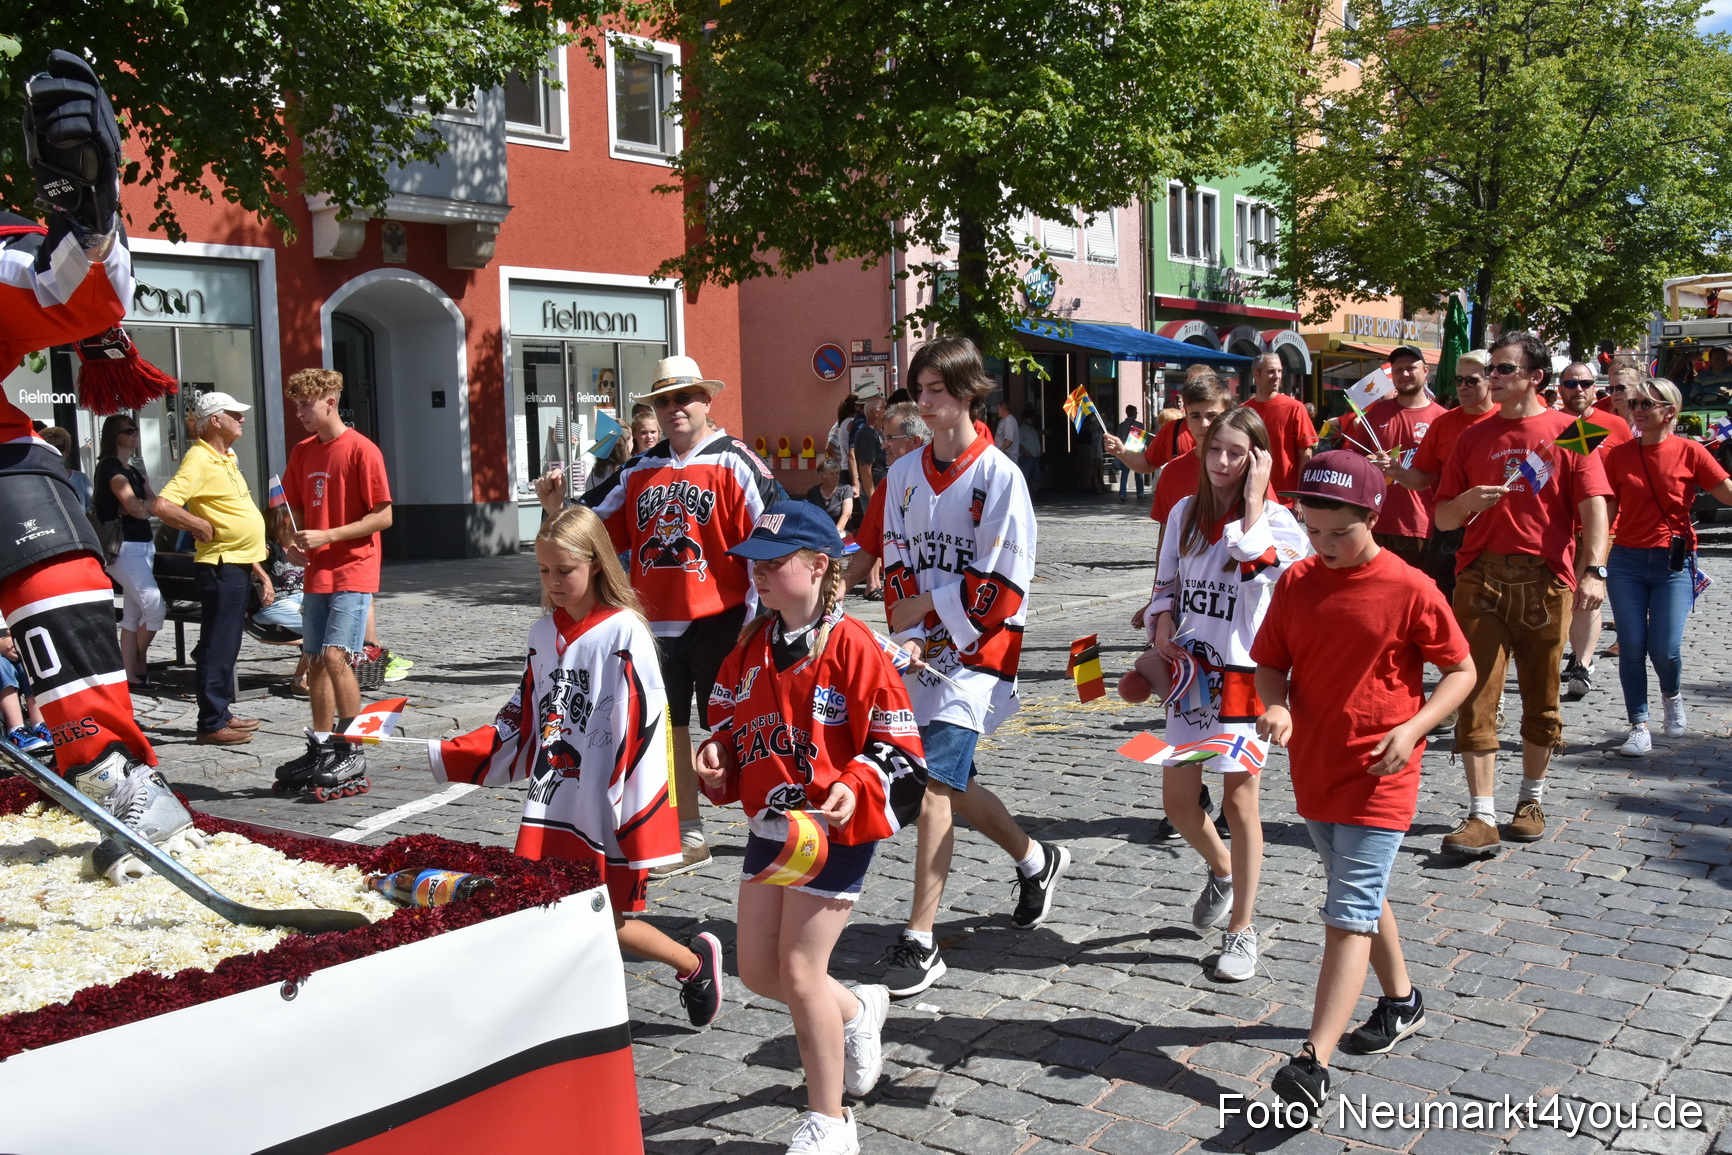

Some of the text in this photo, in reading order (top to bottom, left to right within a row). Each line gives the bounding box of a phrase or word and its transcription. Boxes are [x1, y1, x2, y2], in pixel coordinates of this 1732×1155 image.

[48, 184, 75, 197] HG 120
[1023, 270, 1041, 286] vom
[1030, 280, 1055, 301] ASS
[542, 300, 638, 334] fielmann
[1376, 317, 1420, 341] ROMSTOCK
[19, 388, 76, 404] fielmann
[525, 391, 557, 404] ielmann
[576, 391, 610, 403] fielmann
[1303, 469, 1353, 488] #LAUSBUA
[636, 480, 716, 532] Eagles
[968, 582, 999, 618] 13
[13, 626, 62, 687] 10
[871, 709, 916, 725] Engelb
